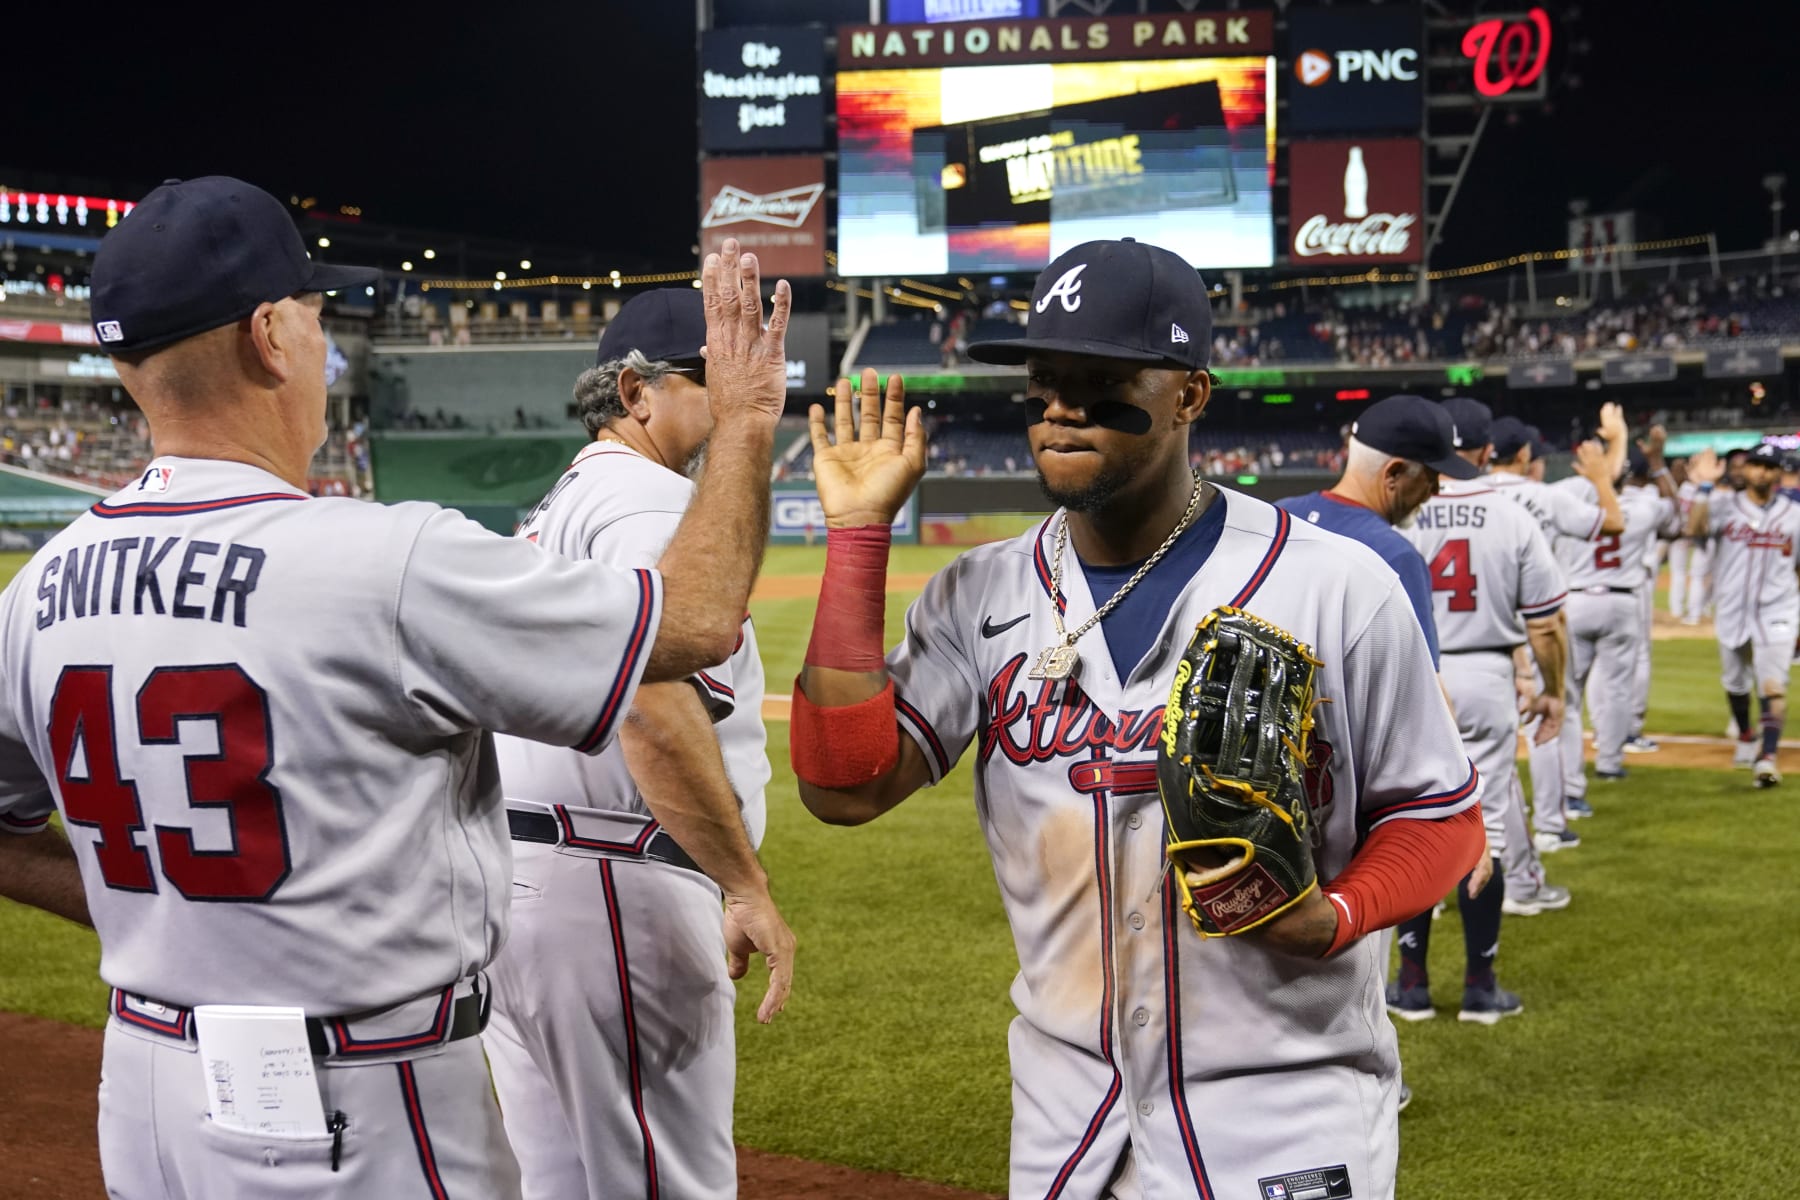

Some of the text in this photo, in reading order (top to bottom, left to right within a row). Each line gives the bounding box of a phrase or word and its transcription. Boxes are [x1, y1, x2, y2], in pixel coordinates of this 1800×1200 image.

[741, 41, 781, 69] The
[852, 17, 1249, 58] NATIONALS PARK
[1462, 7, 1552, 97] W
[703, 68, 821, 100] Washington
[1334, 47, 1418, 83] PNC
[738, 102, 786, 132] Post
[1294, 212, 1417, 257] Coca-Cola
[1035, 263, 1088, 314] A
[1416, 504, 1487, 531] WEISS
[36, 536, 266, 631] SNITKER
[1428, 538, 1477, 612] 4
[982, 651, 1168, 767] Atlan
[1161, 659, 1192, 758] Rawlings
[46, 662, 292, 902] 43
[1211, 878, 1264, 918] Rawlings
